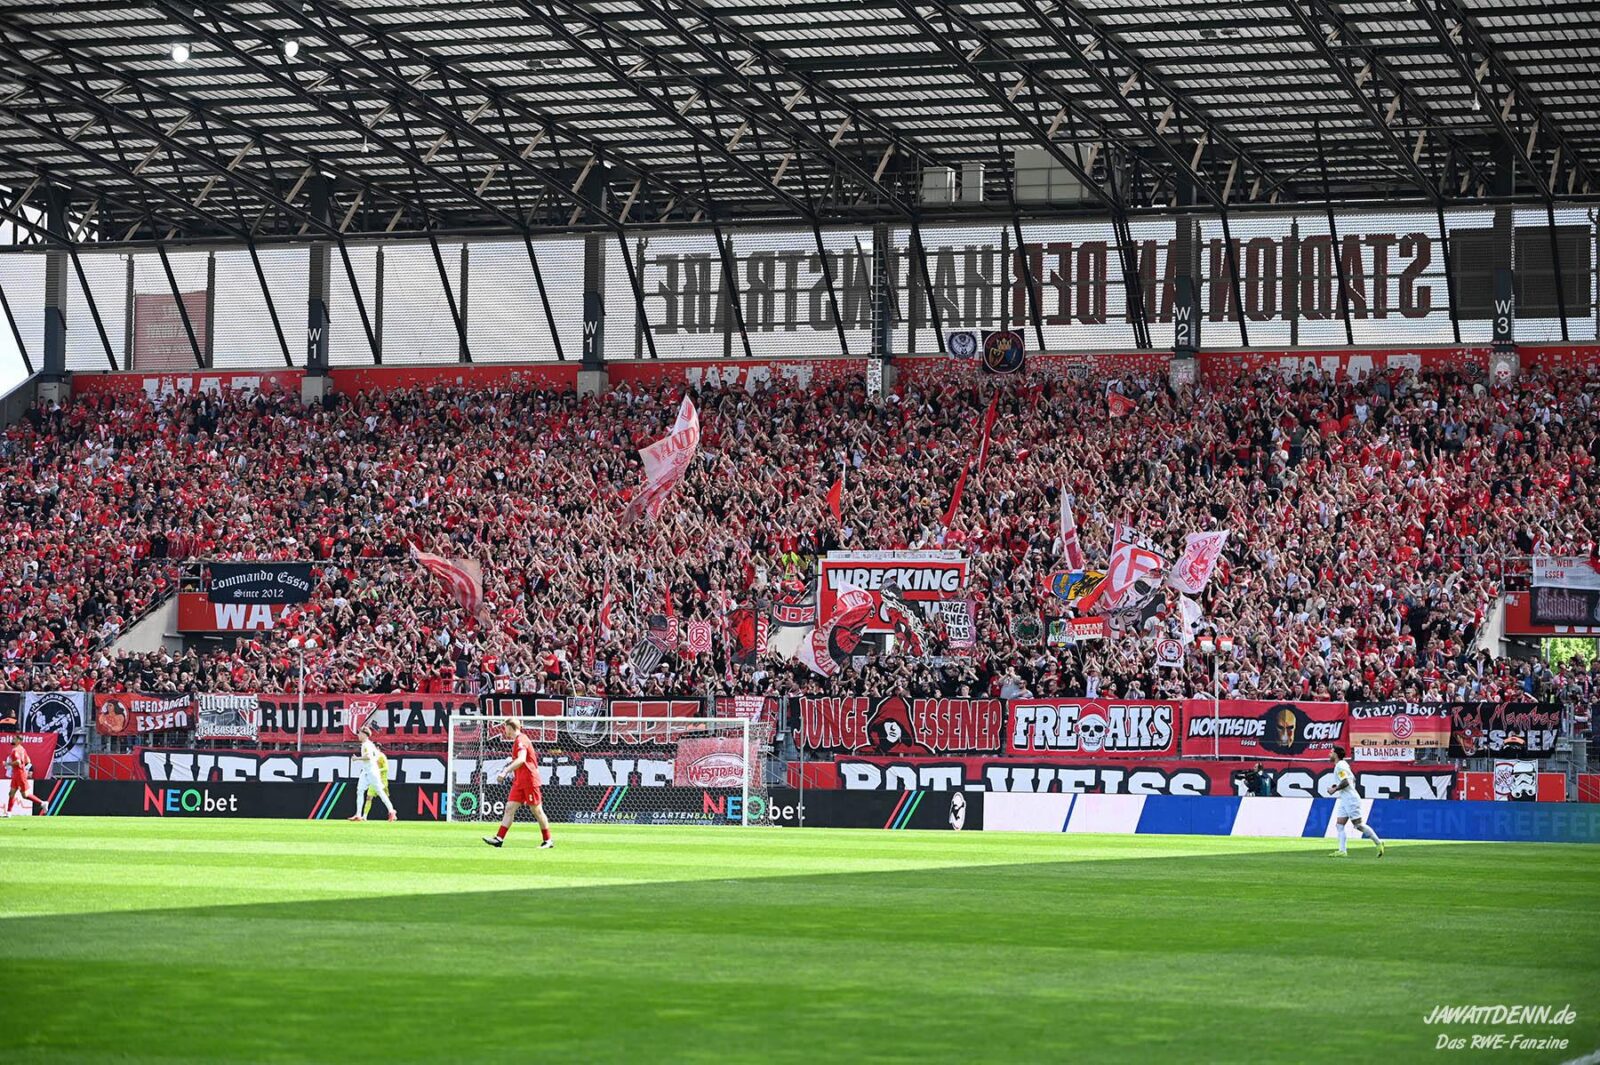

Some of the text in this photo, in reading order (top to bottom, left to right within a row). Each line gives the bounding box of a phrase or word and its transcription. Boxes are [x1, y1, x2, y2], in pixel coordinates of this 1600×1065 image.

[1176, 307, 1191, 339] W 2
[1495, 300, 1511, 334] W 3
[308, 328, 321, 359] W 1
[584, 321, 597, 352] W 1
[211, 569, 274, 590] Commando
[233, 589, 284, 598] Since 2012
[827, 568, 959, 592] WRECKING
[136, 710, 188, 731] ESSEN
[260, 700, 478, 735] RUDE FANS
[794, 697, 870, 751] JUNGE
[913, 698, 1001, 751] ESSENER
[1189, 717, 1343, 739] NORTHSIDE CREW
[1362, 748, 1371, 757] LA
[1374, 748, 1398, 757] BANDA
[144, 783, 238, 817] NEO.bet
